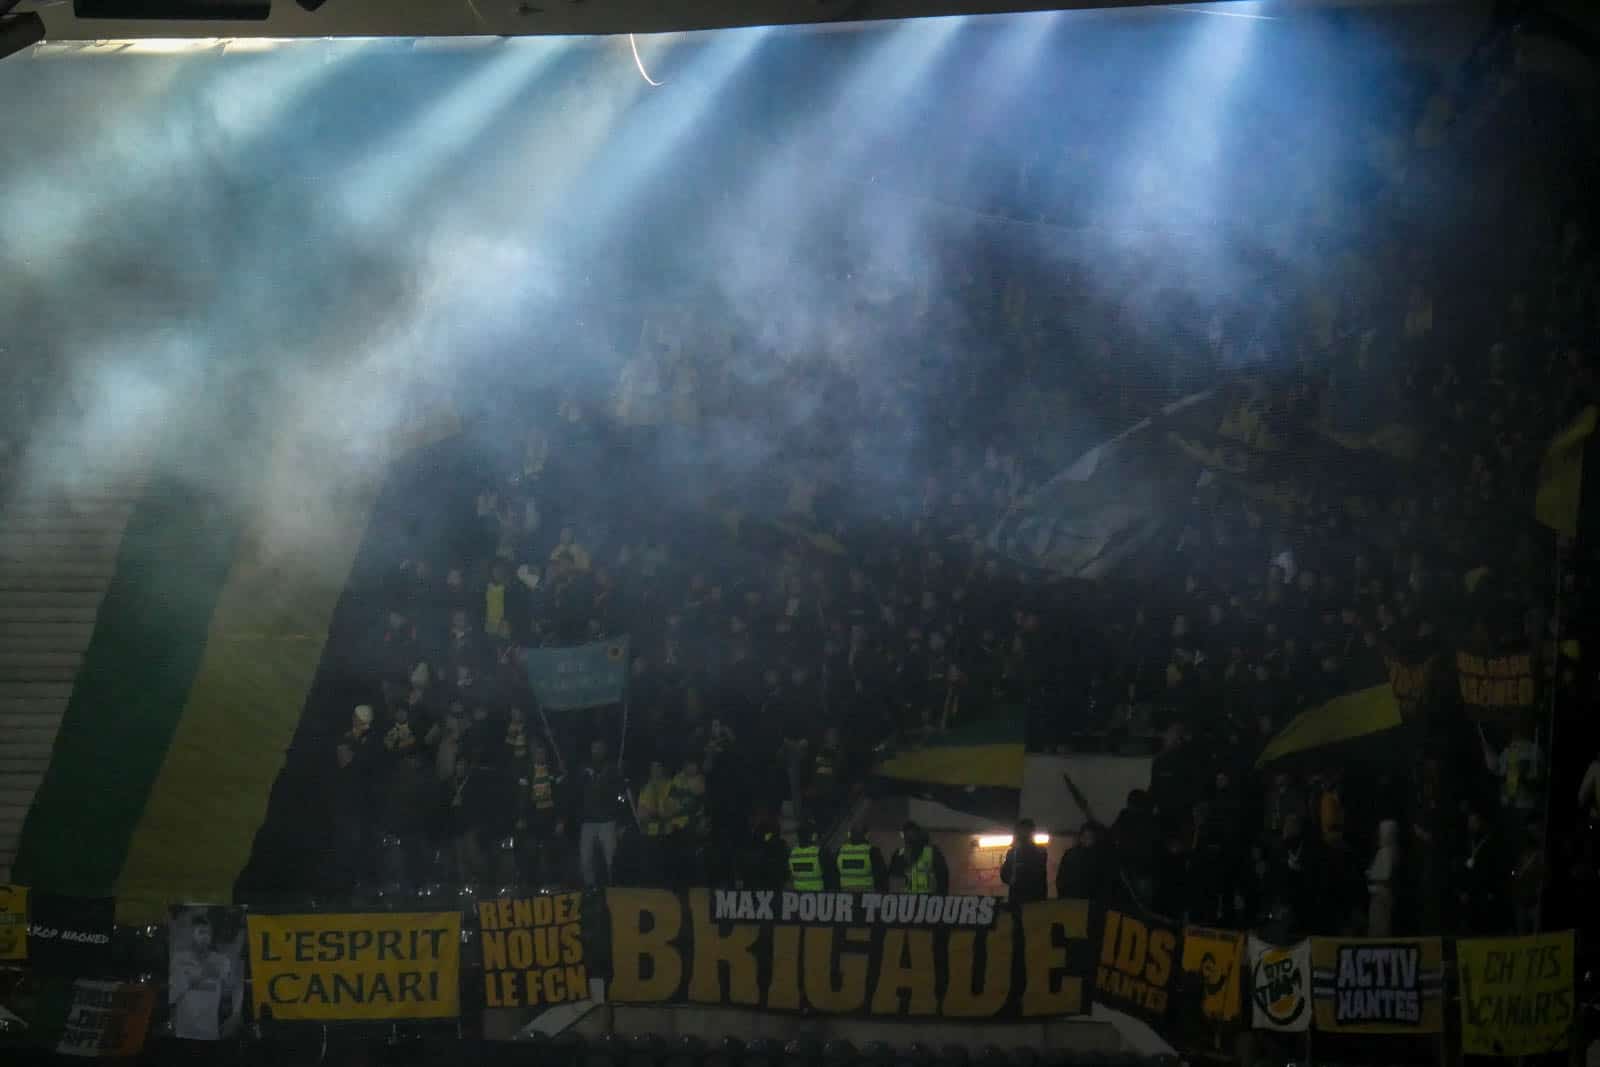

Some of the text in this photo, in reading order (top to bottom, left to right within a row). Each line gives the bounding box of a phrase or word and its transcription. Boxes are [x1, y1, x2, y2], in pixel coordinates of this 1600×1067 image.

[480, 891, 583, 929] RENDEZ
[714, 890, 996, 926] MAX POUR TOUJOURS
[261, 929, 448, 962] L'ESPRIT
[481, 922, 584, 971] NOUS
[606, 887, 1090, 1017] BRIGADE
[485, 964, 590, 1008] LE FCN
[1337, 946, 1419, 989] ACTIV
[268, 971, 439, 1004] CANARI
[1337, 988, 1420, 1023] NANTES
